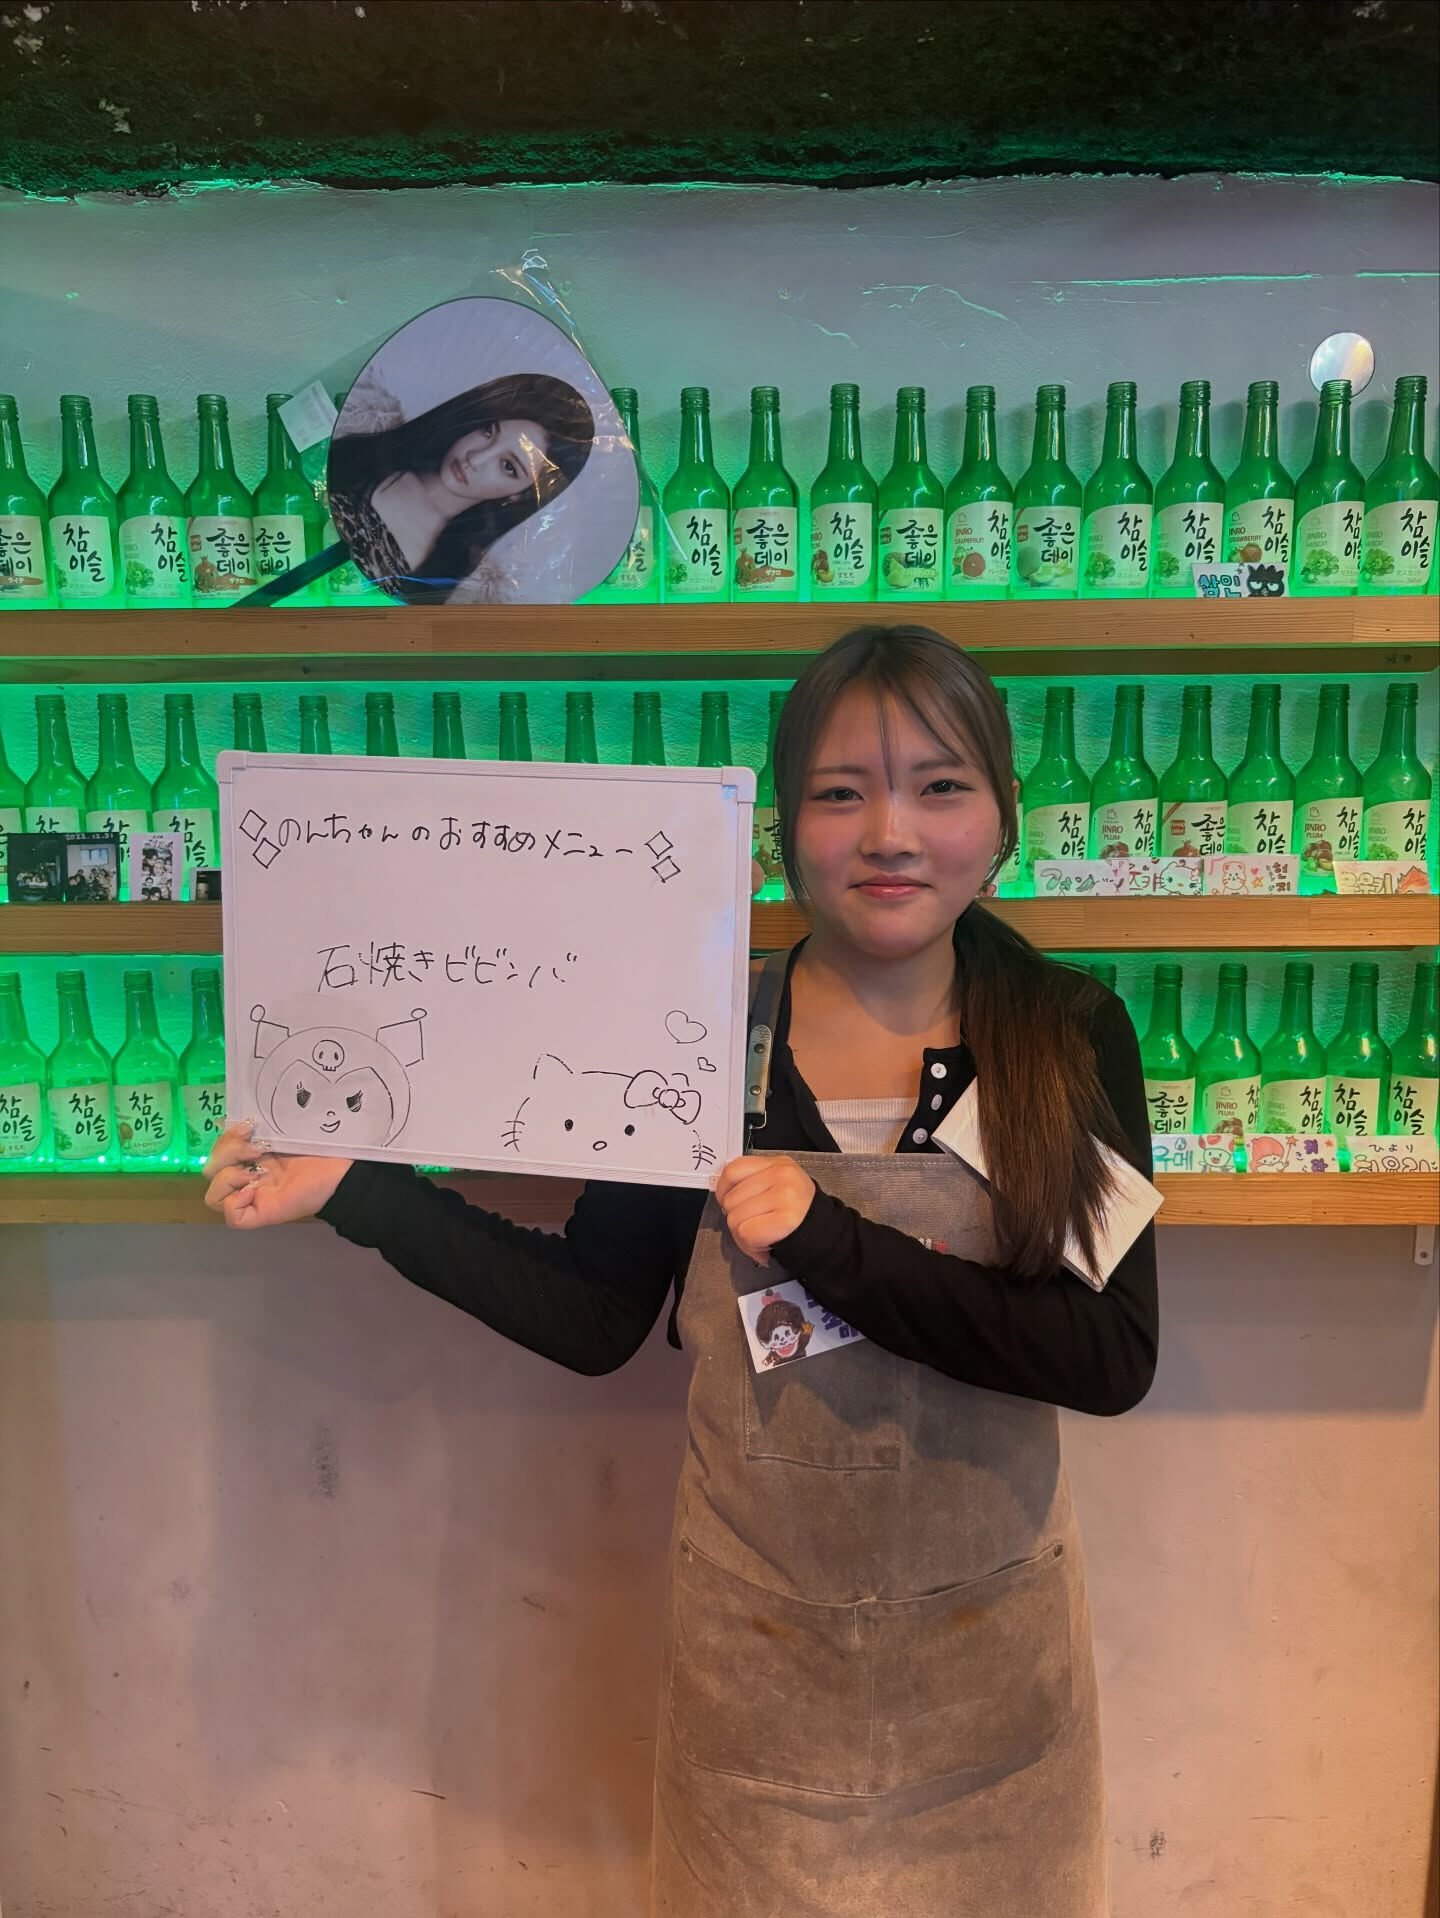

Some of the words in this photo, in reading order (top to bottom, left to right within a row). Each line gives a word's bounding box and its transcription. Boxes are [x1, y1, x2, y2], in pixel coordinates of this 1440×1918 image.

[687, 516, 712, 546] 참
[746, 519, 789, 549] 좋은
[830, 512, 856, 541] 참
[896, 520, 938, 549] 좋은
[987, 510, 1009, 540] 참
[1033, 517, 1075, 547] 좋은
[1117, 512, 1143, 541] 참
[1182, 510, 1210, 540] 참
[1262, 506, 1286, 535] 참
[1342, 508, 1362, 539] 참
[1400, 508, 1428, 539] 참
[63, 522, 90, 552] 참
[151, 522, 178, 552] 참
[206, 528, 250, 557] 좋은
[256, 528, 291, 557] 좋은
[1264, 533, 1289, 563] 이슬
[69, 550, 105, 582] 이슬
[216, 557, 250, 575] 데이
[692, 544, 722, 576] 이슬
[754, 549, 788, 567] 데이
[834, 538, 864, 569] 이슬
[904, 549, 937, 568] 데이
[991, 538, 1011, 570] 이슬
[1041, 547, 1073, 563] 데이
[1120, 539, 1148, 571] 이슬
[1401, 536, 1430, 568] 이슬
[158, 552, 188, 582] 이슬
[278, 813, 634, 858] のんちゃんのおすすめメニュー
[1058, 811, 1082, 839] 참
[1102, 825, 1124, 834] JINRO
[1133, 808, 1153, 837] 참
[1191, 814, 1226, 841] 좋은
[1254, 808, 1280, 837] 참
[1304, 823, 1326, 833] JINRO
[1336, 806, 1358, 837] 참
[1402, 808, 1425, 837] 참
[1200, 840, 1225, 856] 데이
[316, 942, 578, 993] 石焼きビビンバ
[0, 1093, 22, 1118] 참
[69, 1093, 96, 1118] 참
[129, 1091, 153, 1116] 참
[198, 1090, 224, 1116] 참
[1147, 1092, 1188, 1118] 좋은
[1216, 1101, 1237, 1110] JINRO
[1300, 1086, 1321, 1111] 참
[1334, 1083, 1360, 1111] 참
[1393, 1081, 1417, 1109] 참
[3, 1115, 36, 1141] 이슬
[76, 1114, 108, 1142] 이슬
[135, 1112, 165, 1138] 이슬
[1154, 1117, 1186, 1133] 데이
[1336, 1109, 1368, 1136] 이슬
[1394, 1108, 1425, 1136] 이슬
[1368, 1144, 1414, 1153] ひより
